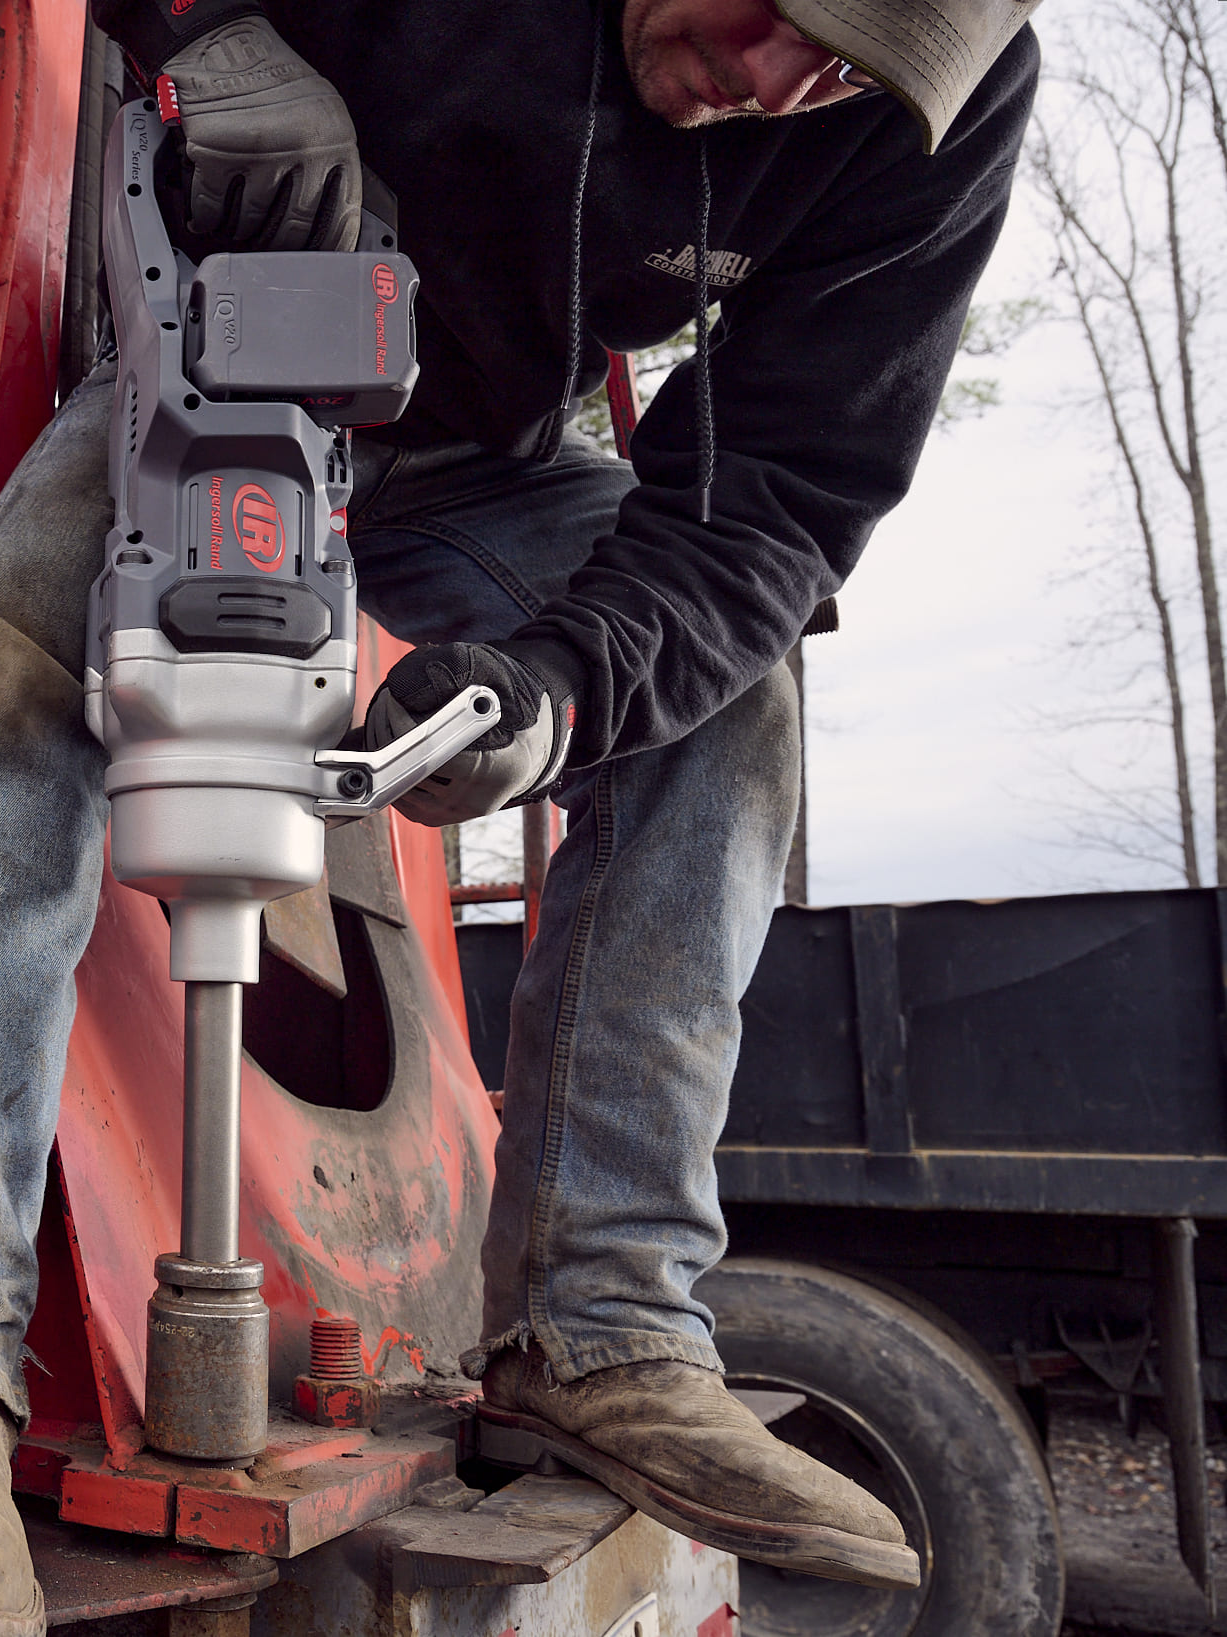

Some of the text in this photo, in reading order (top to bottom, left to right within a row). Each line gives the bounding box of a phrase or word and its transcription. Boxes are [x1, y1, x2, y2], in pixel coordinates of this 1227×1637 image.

[131, 151, 141, 181] Series
[374, 303, 388, 347] Ingersoll
[376, 348, 388, 376] Rand
[299, 396, 345, 405] 20V
[209, 476, 224, 570] Ingersoll Rand
